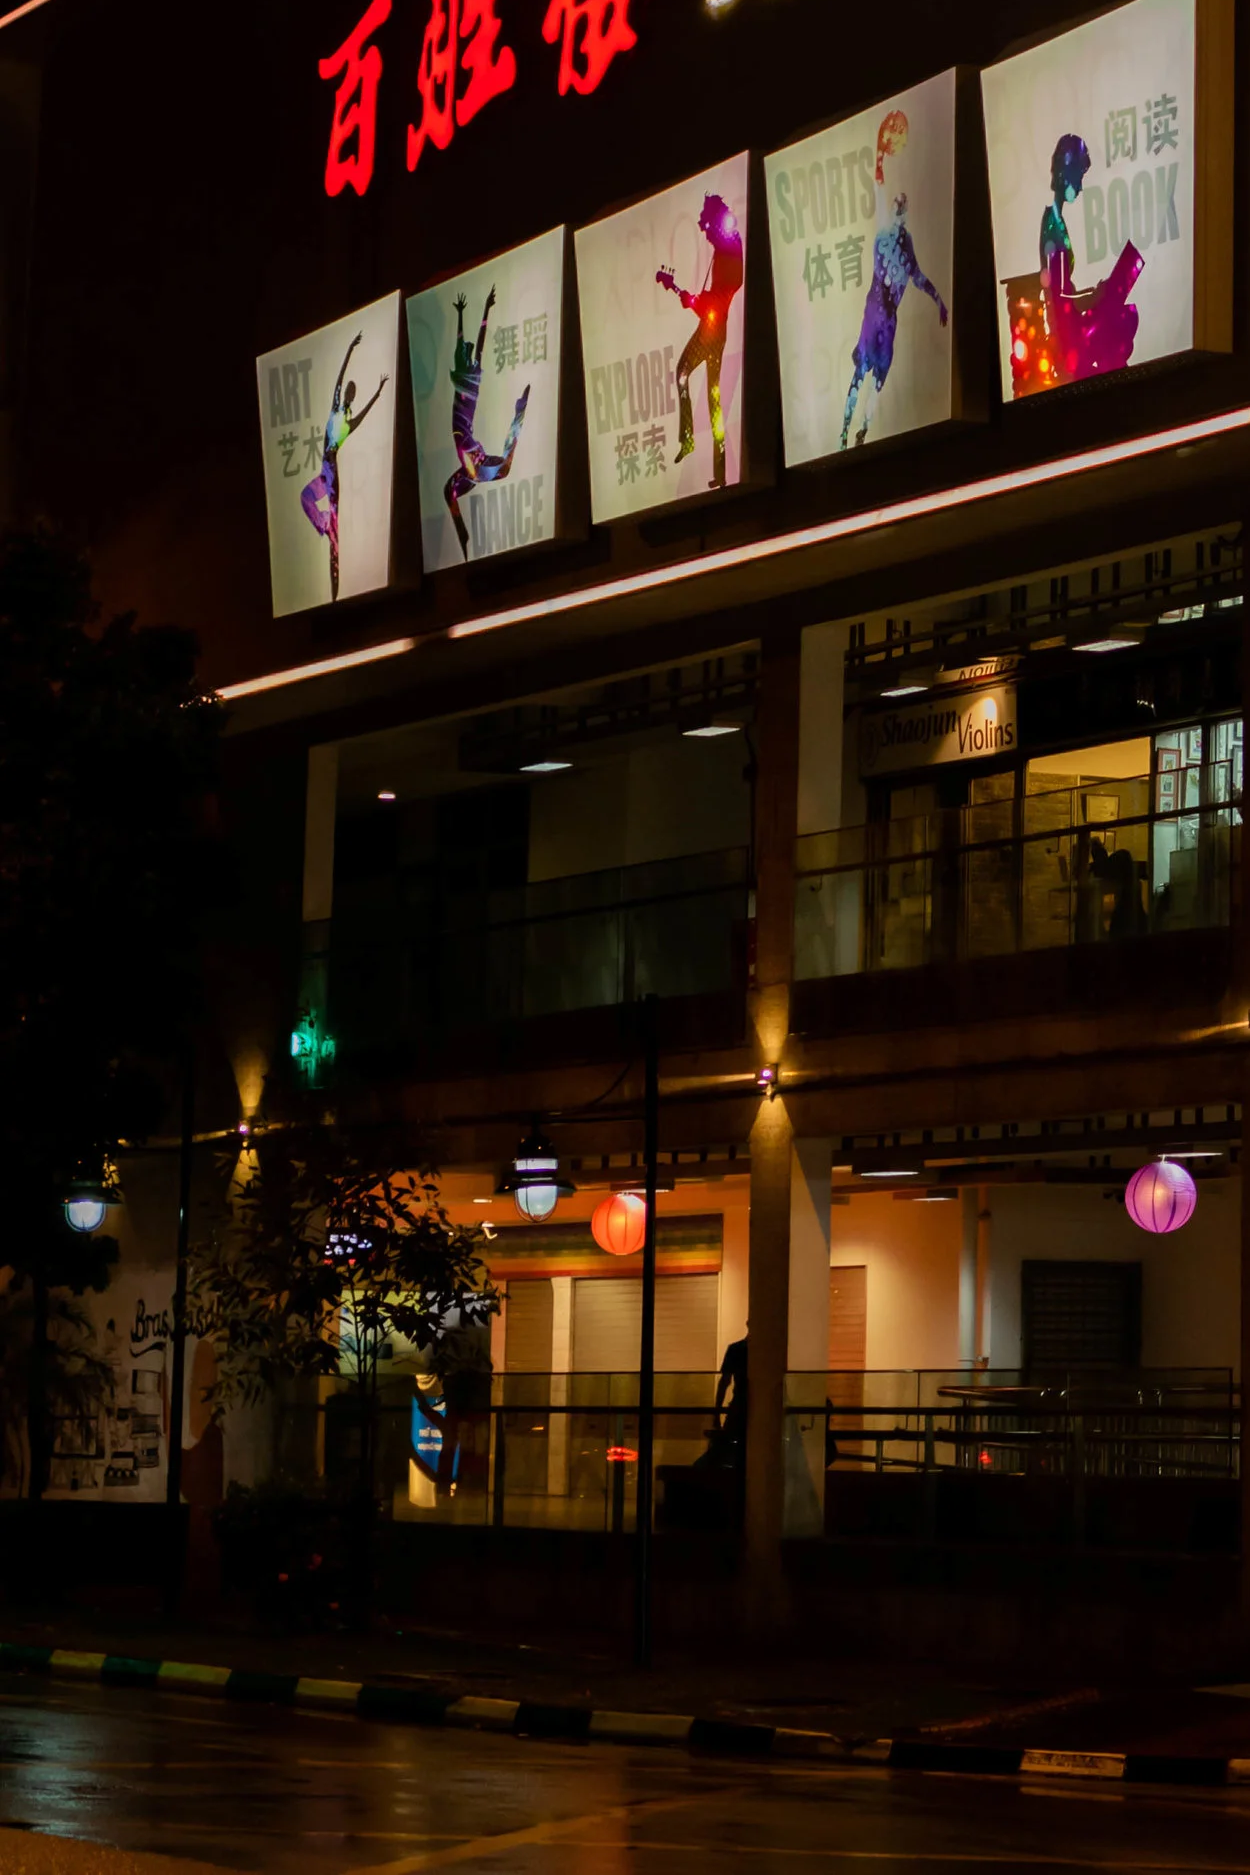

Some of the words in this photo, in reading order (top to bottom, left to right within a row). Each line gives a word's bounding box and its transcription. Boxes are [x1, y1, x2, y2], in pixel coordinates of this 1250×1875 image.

[1104, 93, 1179, 169] 阅读
[774, 145, 876, 246] SPORTS
[1083, 161, 1180, 266] BOOK
[803, 234, 866, 303] 体育
[492, 313, 550, 374] 舞蹈
[268, 357, 314, 429] ART
[590, 344, 676, 435] EXPLORE
[277, 431, 323, 478] 艺术
[614, 424, 668, 486] 探索
[469, 473, 544, 557] DANCE
[879, 707, 957, 749] Shaojun
[957, 712, 1014, 754] Violins
